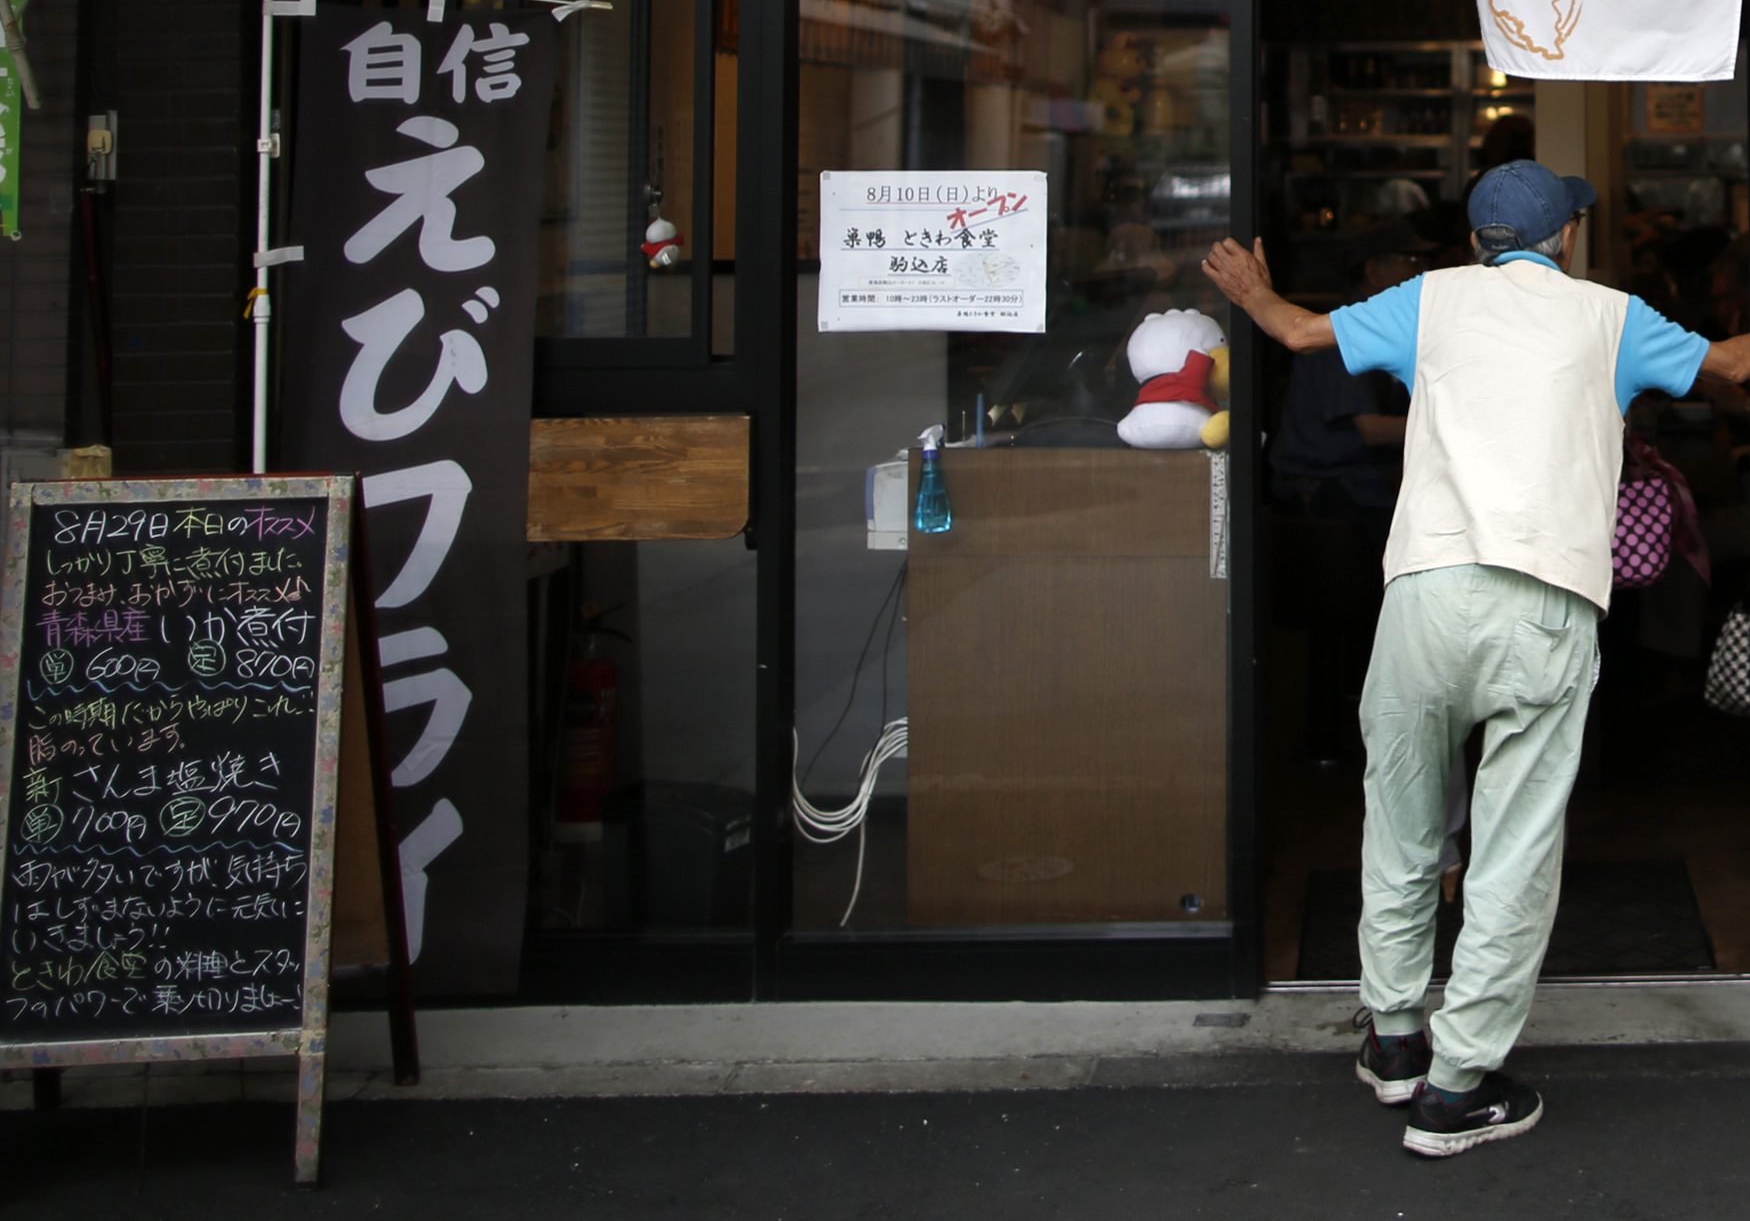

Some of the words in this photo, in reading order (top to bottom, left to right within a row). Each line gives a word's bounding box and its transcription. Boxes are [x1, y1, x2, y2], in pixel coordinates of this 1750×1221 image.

[339, 21, 530, 105] 自信
[947, 192, 1028, 230] オープン
[904, 228, 999, 249] ときわ食堂
[889, 255, 950, 274] 駒込店
[36, 608, 151, 647] 青森県産
[161, 606, 317, 647] いか煮付
[72, 751, 281, 802] さんま塩焼き
